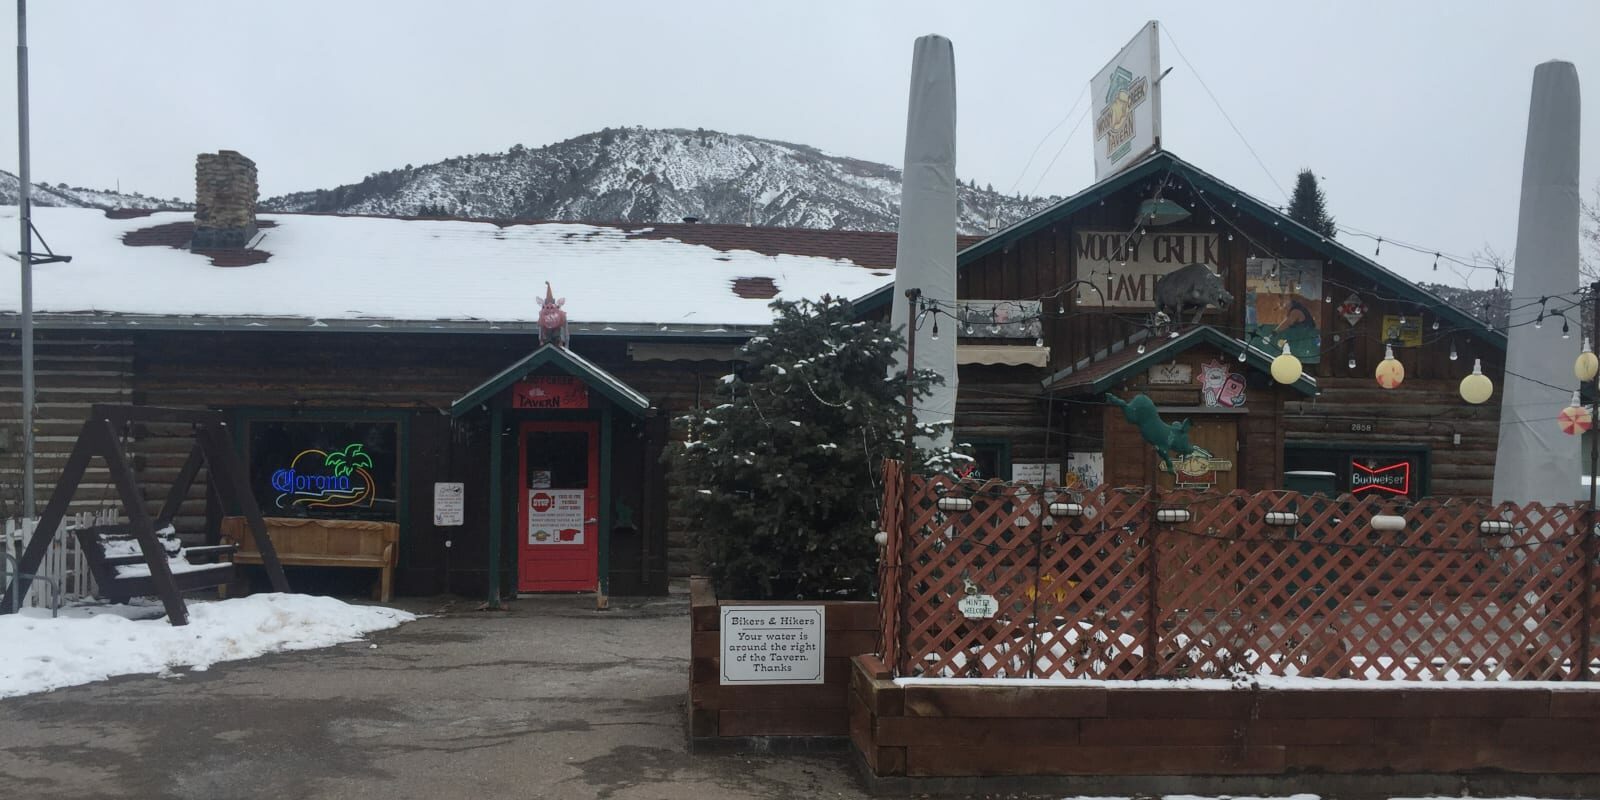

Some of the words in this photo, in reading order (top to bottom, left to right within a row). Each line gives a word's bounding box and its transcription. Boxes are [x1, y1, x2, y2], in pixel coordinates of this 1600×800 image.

[1078, 234, 1143, 263] WOODY
[518, 394, 560, 408] TAVERN
[271, 468, 350, 494] Corona
[1352, 472, 1405, 486] Budweiser
[965, 607, 992, 615] WELCOME
[731, 617, 765, 626] Bikers
[769, 617, 777, 625] &
[780, 616, 815, 625] Hikers
[738, 632, 762, 641] Your
[766, 633, 796, 641] water
[799, 632, 808, 641] is
[729, 643, 767, 652] around
[770, 643, 787, 651] the
[790, 642, 816, 653] right
[736, 653, 747, 662] of
[750, 653, 766, 662] the
[769, 653, 809, 661] Tavern.
[753, 663, 792, 672] Thanks
